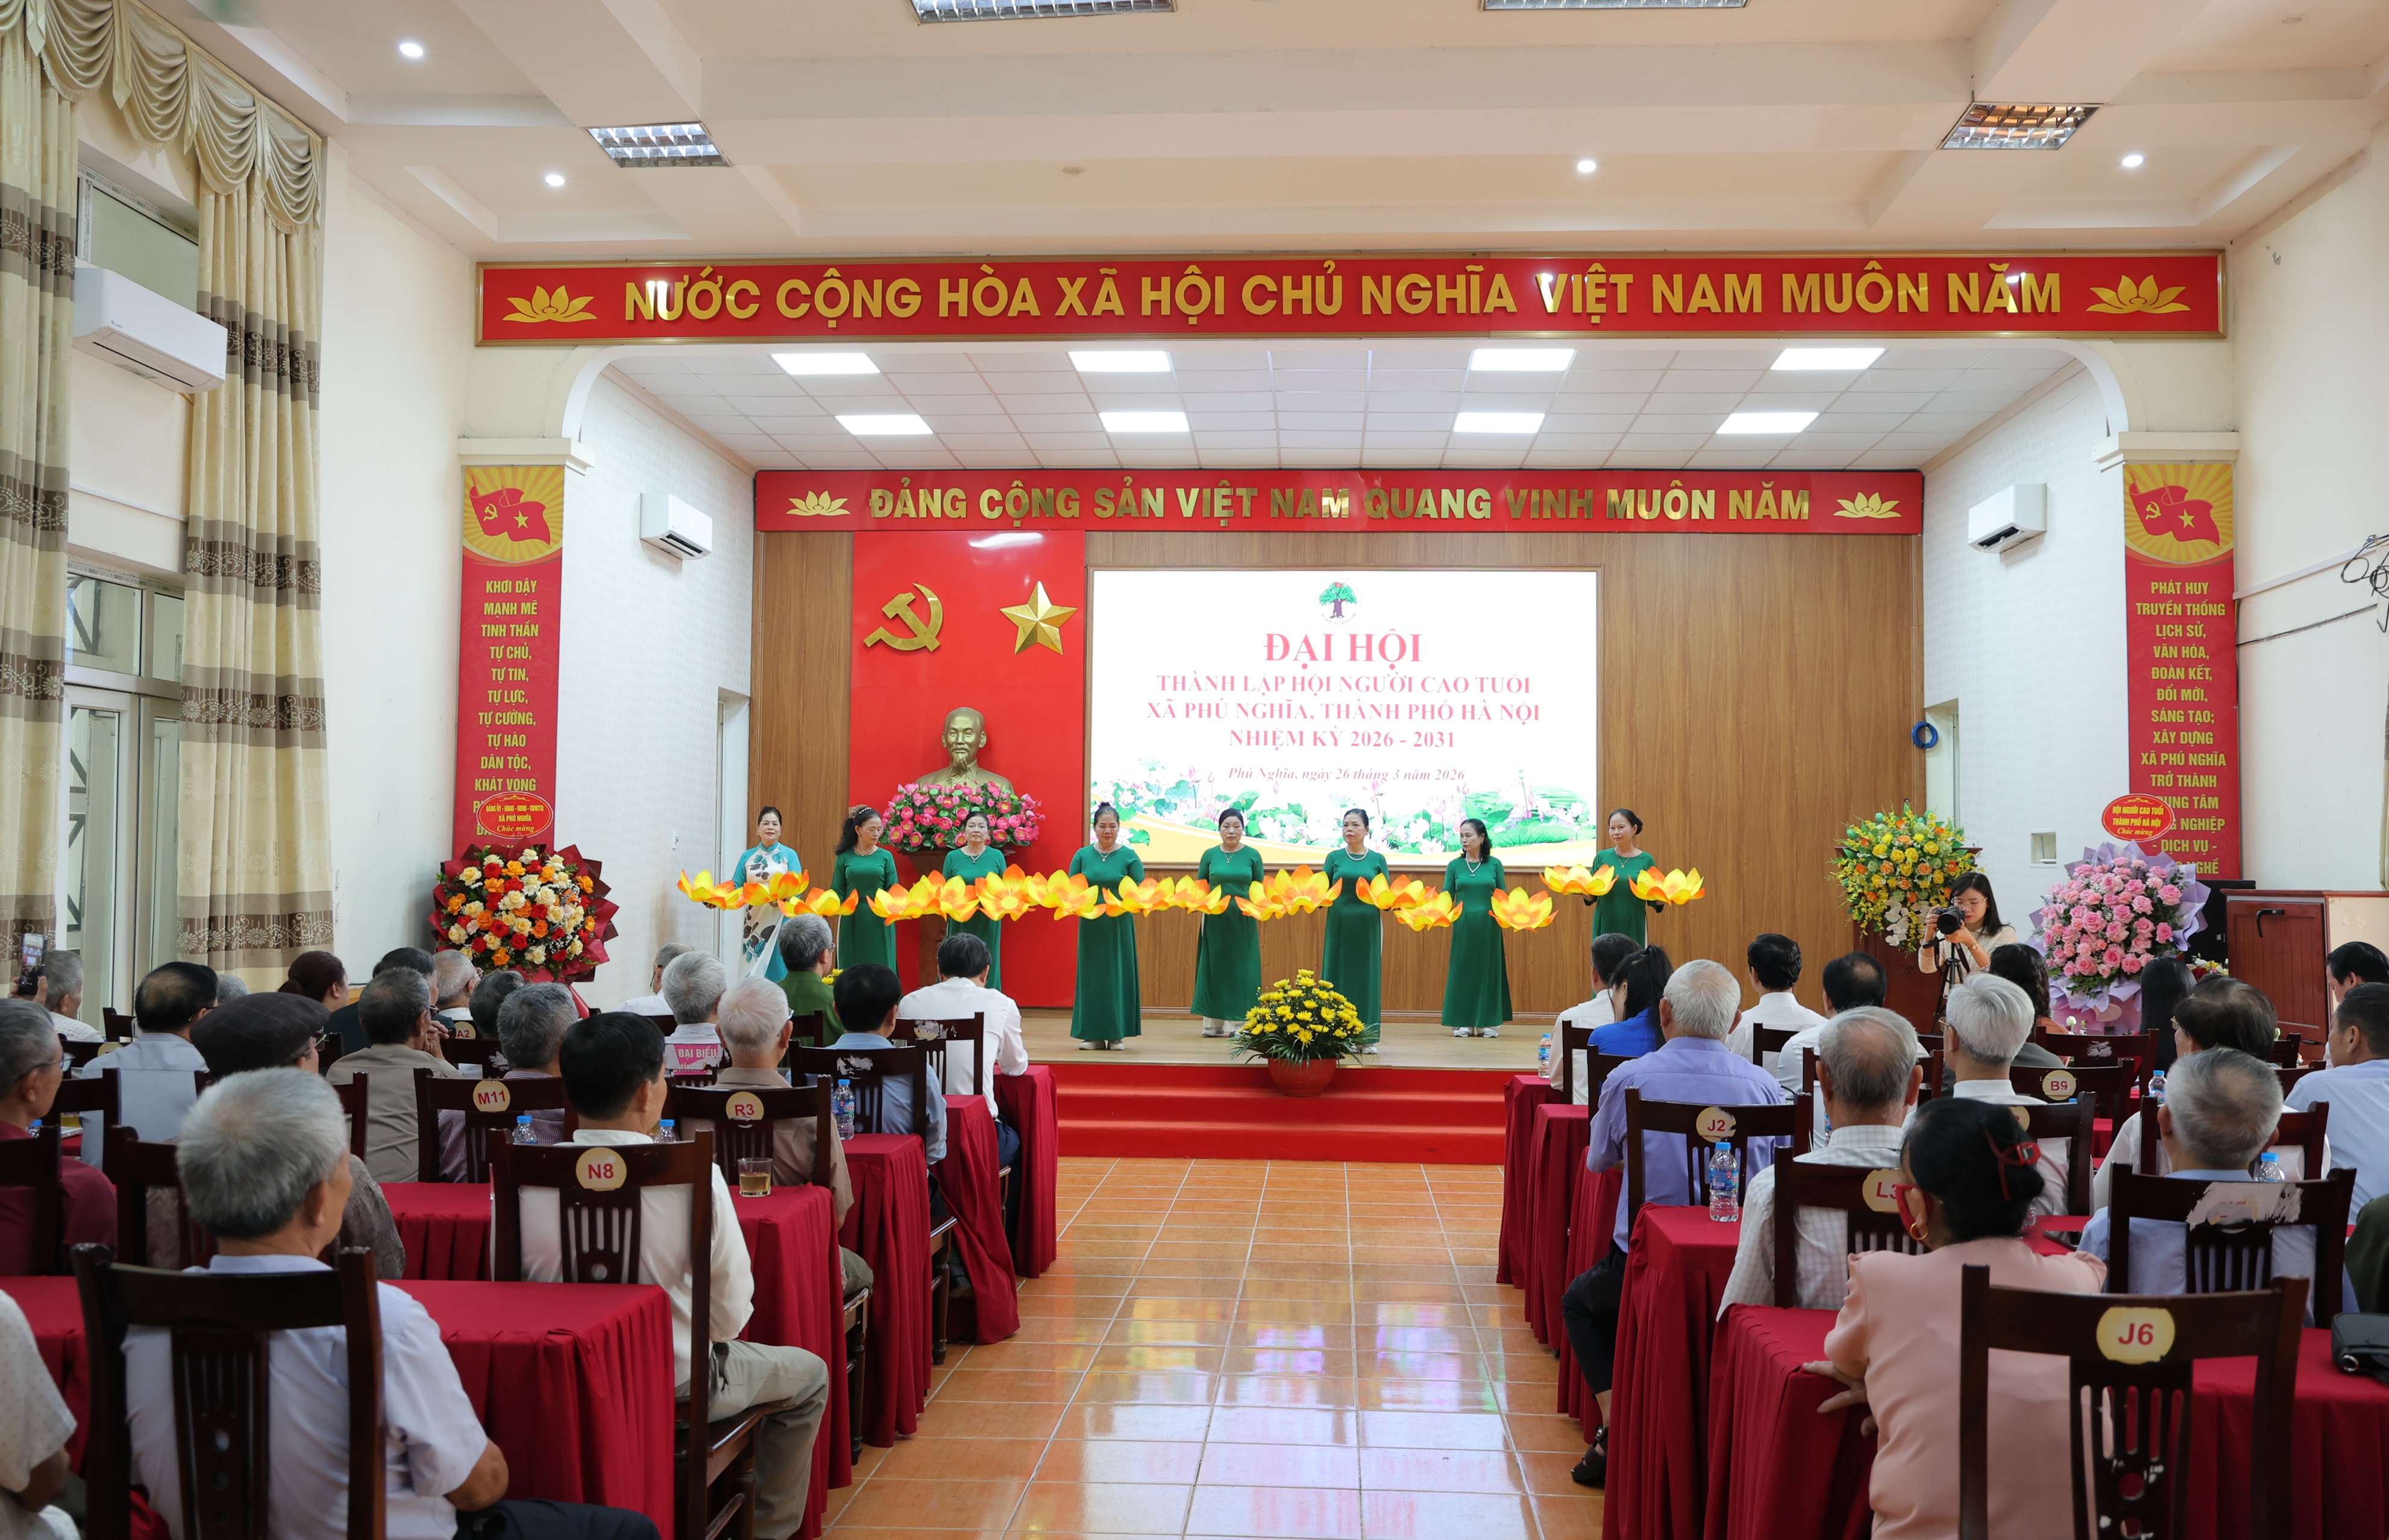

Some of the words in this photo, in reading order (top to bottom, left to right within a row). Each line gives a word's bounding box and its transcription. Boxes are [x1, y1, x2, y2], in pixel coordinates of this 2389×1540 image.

[625, 266, 761, 321] NƯỚC
[776, 267, 922, 328] CỘNG
[938, 263, 1041, 318] HÒA
[1054, 267, 1126, 316] XÃ
[1141, 264, 1225, 325] HỘI
[1242, 260, 1343, 316] CHỦ
[1361, 264, 1518, 315] NGHĨA
[1534, 262, 1634, 324] VIỆT
[1652, 273, 1762, 314] NAM
[1782, 260, 1929, 314] MUÔN
[1948, 263, 2061, 314] NĂM
[869, 477, 967, 519] ĐẢNG
[979, 480, 1080, 527] CỘNG
[1093, 476, 1165, 519] SẢN
[1175, 480, 1258, 527] VIỆT
[1270, 487, 1351, 519] NAM
[1363, 487, 1492, 521] QUANG
[1502, 487, 1593, 519] VINH
[1606, 480, 1716, 521] MUÔN
[1728, 481, 1810, 521] NĂM
[486, 580, 512, 594] KHƠI
[516, 578, 538, 596] DẬY
[2151, 580, 2183, 595] PHÁT
[2186, 582, 2209, 595] HUY
[484, 603, 518, 619] MẠNH
[521, 599, 538, 616] MẼ
[2136, 599, 2183, 616] TRUYỀN
[2185, 599, 2226, 616] THỐNG
[481, 624, 507, 638] TINH
[510, 620, 539, 638] THẦN
[2156, 624, 2183, 640] LỊCH
[2187, 621, 2207, 639] SỬ,
[490, 645, 505, 663] TỰ
[507, 642, 533, 661] CHỦ,
[1263, 633, 1335, 670] ĐẠI
[1346, 628, 1422, 671] HỘI
[2153, 643, 2179, 659] VĂN
[2182, 645, 2210, 660] HÓA,
[491, 667, 506, 684] TỰ
[508, 668, 529, 683] TIN,
[2152, 665, 2185, 680] ĐOÀN
[2189, 664, 2213, 681] KẾT,
[1157, 671, 1235, 692] THÀNH
[1243, 673, 1286, 696] LẬP
[1292, 673, 1331, 696] HỘI
[1339, 671, 1413, 693] NGƯỜI
[1421, 676, 1469, 693] CAO
[488, 689, 503, 707] TỰ
[504, 689, 529, 707] LỰC,
[2157, 684, 2177, 702] ĐỔI
[2181, 687, 2209, 703] MỚI,
[479, 711, 494, 728] TỰ
[495, 709, 537, 727] CƯỜNG,
[1147, 698, 1177, 719] XÃ
[1184, 698, 1228, 719] PHÚ
[1236, 698, 1314, 721] NGHĨA,
[1320, 698, 1399, 720] THÀNH
[1408, 699, 1454, 721] PHỐ
[1461, 699, 1493, 721] HÀ
[1499, 701, 1539, 725] NỘI
[2151, 707, 2185, 723] SÁNG
[2188, 710, 2215, 726] TẠO;
[488, 733, 502, 751] TỰ
[504, 731, 527, 748] HÀO
[1229, 727, 1304, 751] NHIỆM
[1313, 725, 1343, 747] KỲ
[1350, 731, 1394, 748] 2026
[1413, 731, 1454, 748] 2031
[2153, 729, 2177, 745] XÂY
[2180, 731, 2214, 748] DỰNG
[481, 754, 504, 770] DÂN
[507, 754, 532, 772] TỘC,
[2141, 751, 2158, 766] XÃ
[2161, 751, 2186, 766] PHÚ
[2189, 751, 2227, 767] NGHĨA
[475, 775, 504, 792] KHÁT
[1228, 767, 1254, 779] Phú
[1258, 767, 1298, 782] Nghĩa,
[1302, 768, 1333, 783] ngày
[1335, 768, 1350, 780] 26
[1353, 768, 1389, 783] tháng
[1392, 769, 1399, 780] 3
[1403, 769, 1431, 780] năm
[1434, 769, 1465, 781] 2026
[2150, 771, 2174, 787] TRỞ
[2177, 772, 2217, 788] THÀNH
[2156, 796, 2190, 809] UNG
[2193, 793, 2220, 810] TÂM
[517, 813, 532, 822] NGHĨA
[2112, 816, 2129, 826] THÀNH
[2142, 817, 2150, 827] HÀ
[2150, 818, 2162, 829] NỘI
[2180, 815, 2226, 834] NGHIỆP
[515, 824, 535, 833] mừng
[2134, 828, 2153, 837] mừng
[2161, 839, 2190, 854] DỊCH
[2193, 839, 2209, 855] VỤ
[457, 1030, 470, 1038] A2
[678, 1048, 693, 1060] ĐẠI
[695, 1045, 717, 1058] BIỂU
[477, 1090, 506, 1105] M11
[734, 1103, 755, 1116] R3
[1707, 1119, 1726, 1132] J2
[588, 1163, 614, 1180] N8
[2118, 1321, 2154, 1346] J6
